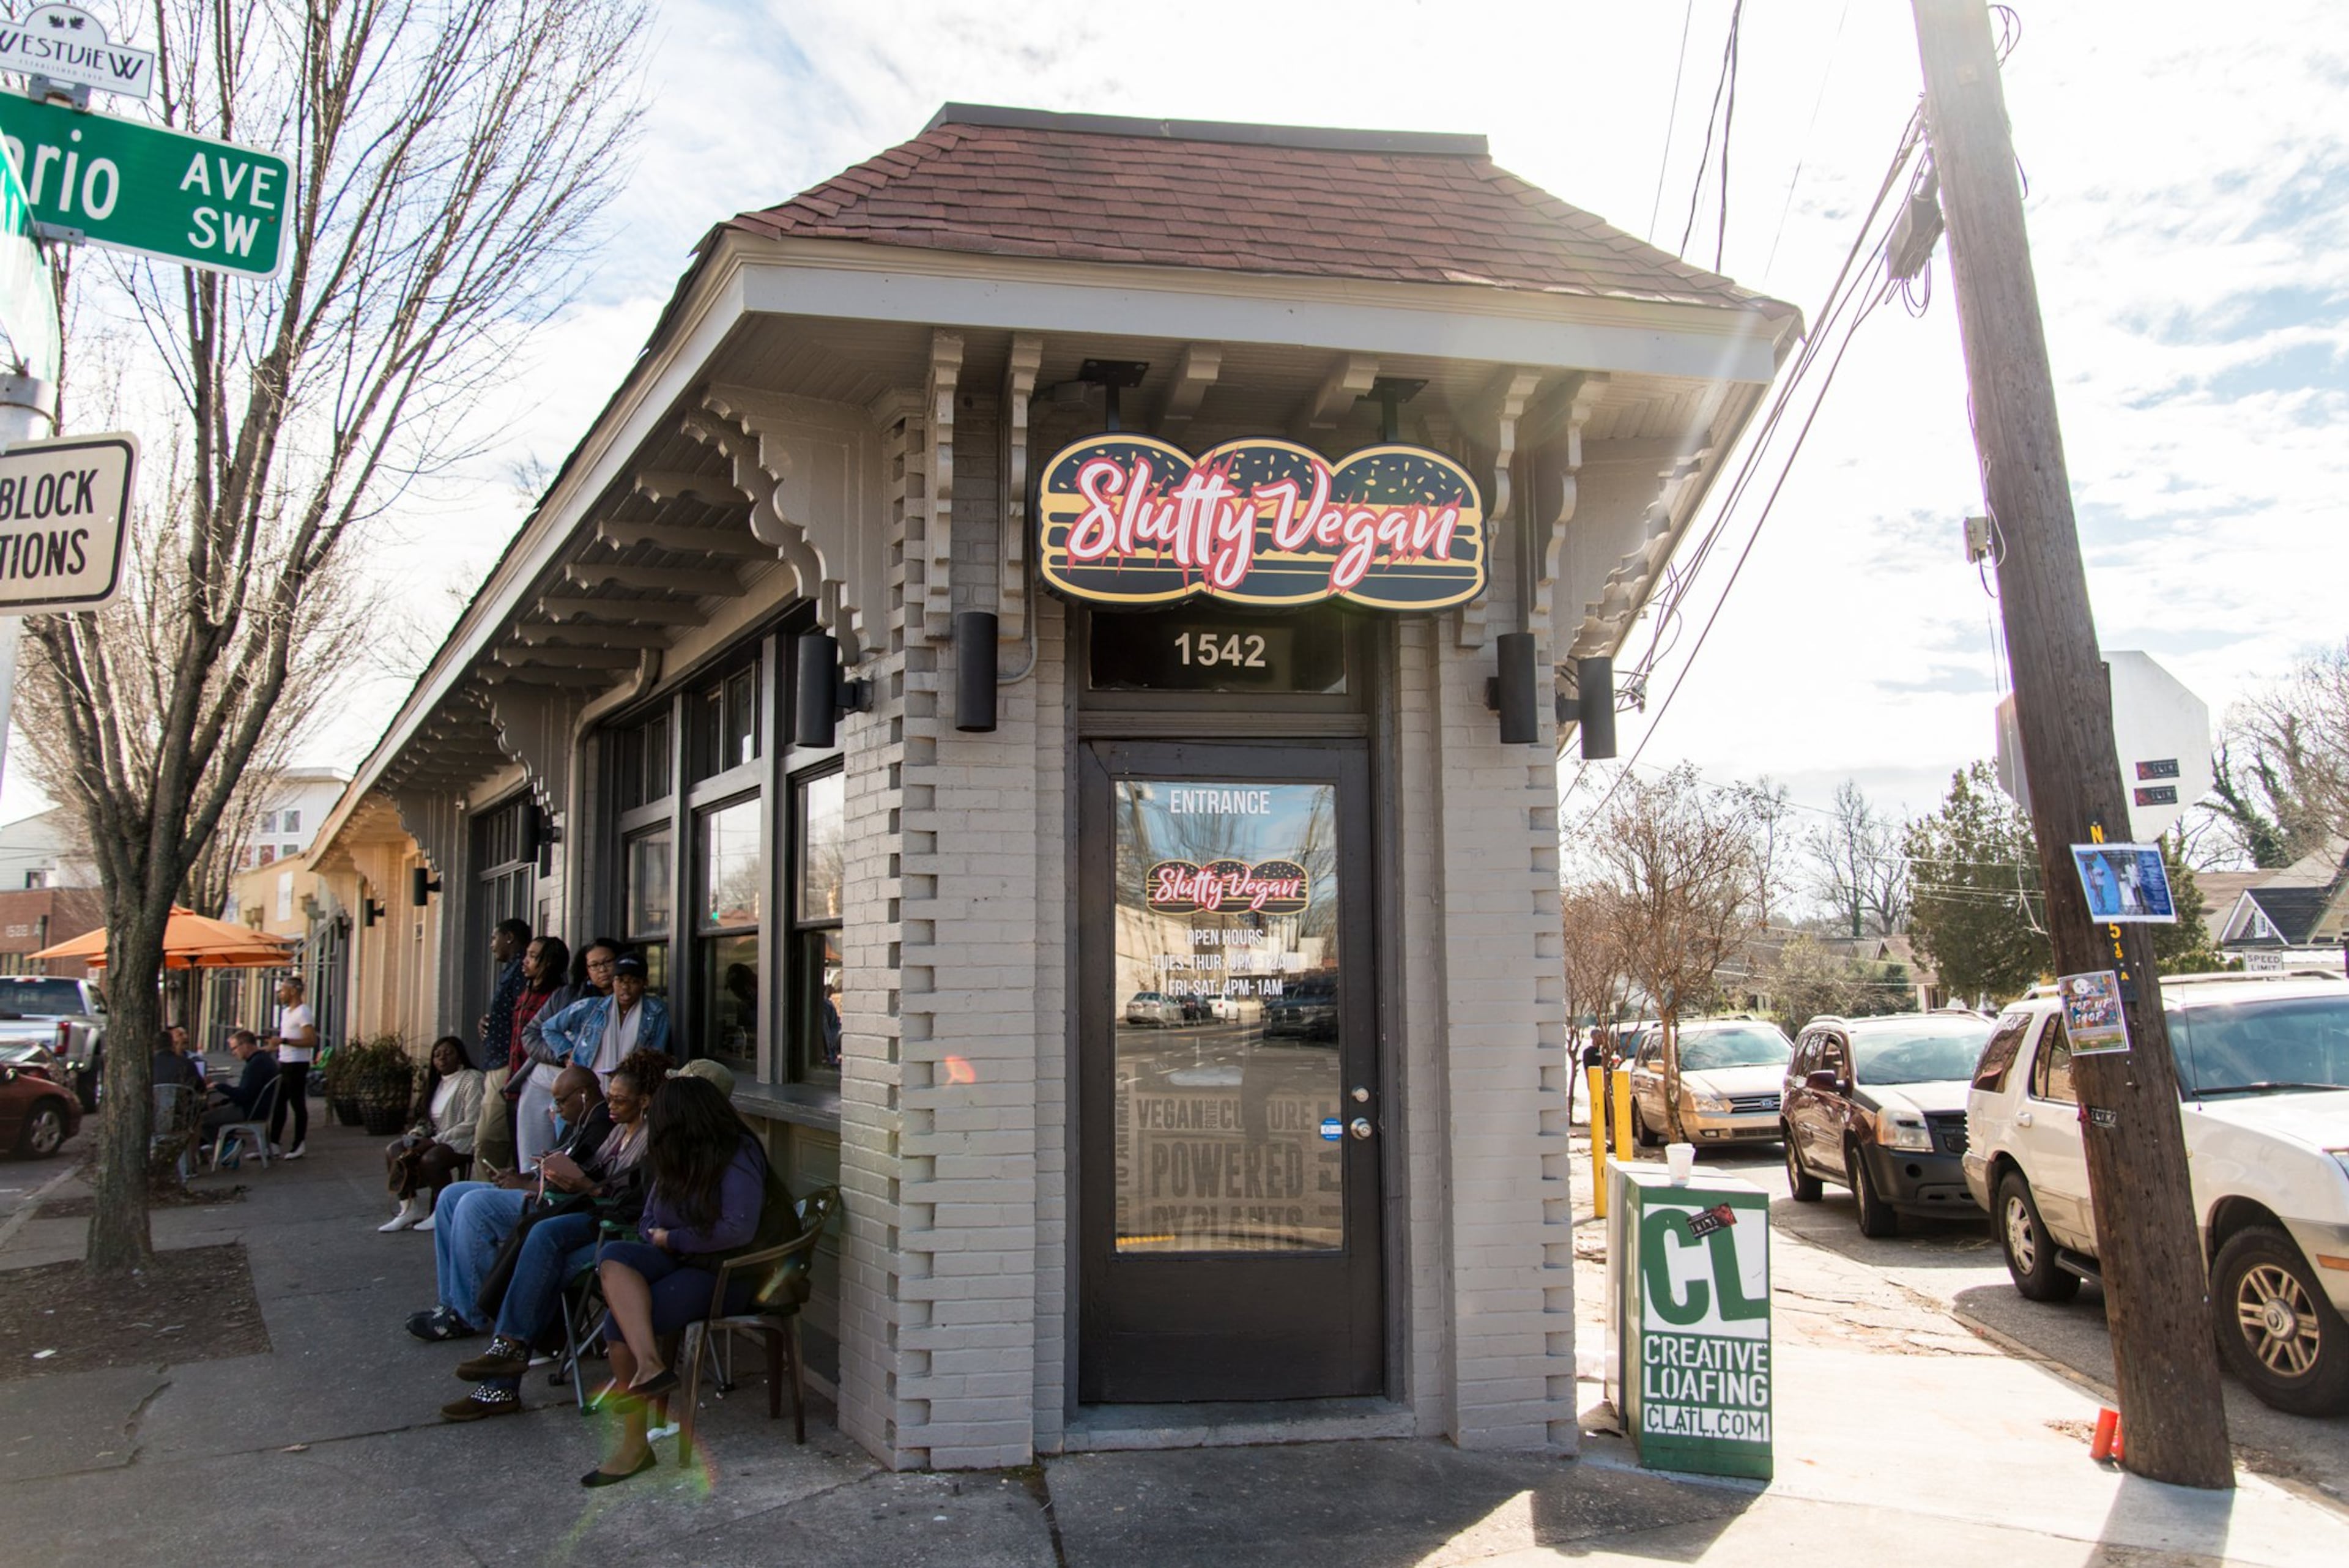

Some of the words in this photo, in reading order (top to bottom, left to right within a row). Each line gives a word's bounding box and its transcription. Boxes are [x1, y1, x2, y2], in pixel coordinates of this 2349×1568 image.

[179, 152, 278, 210] AVE
[188, 207, 260, 257] SW
[0, 469, 98, 520] BLOCK
[1066, 451, 1256, 591] Slutty
[1255, 459, 1461, 593] Vegan
[1174, 633, 1266, 667] 1542
[1170, 790, 1271, 814] ENTRANCE
[2090, 825, 2104, 844] N
[1154, 866, 1224, 910] Slutty
[1222, 866, 1301, 910] Vegan
[1187, 929, 1219, 945] OPEN
[1222, 929, 1264, 945] HOURS
[2247, 955, 2280, 964] SPEED
[2070, 1000, 2091, 1011] POP
[2095, 997, 2113, 1008] UP
[2076, 1010, 2106, 1024] SHOP
[1137, 1099, 1204, 1129] VEGAN
[1220, 1101, 1312, 1131] CUURE
[1152, 1142, 1304, 1198] POWERED
[1152, 1205, 1187, 1249] BY
[1192, 1205, 1304, 1249] PLANTS
[1641, 1205, 1768, 1326] CL
[1644, 1334, 1768, 1373] CREATIVE
[1644, 1365, 1768, 1406] LOAFING
[1647, 1406, 1765, 1438] CLATL.COM
